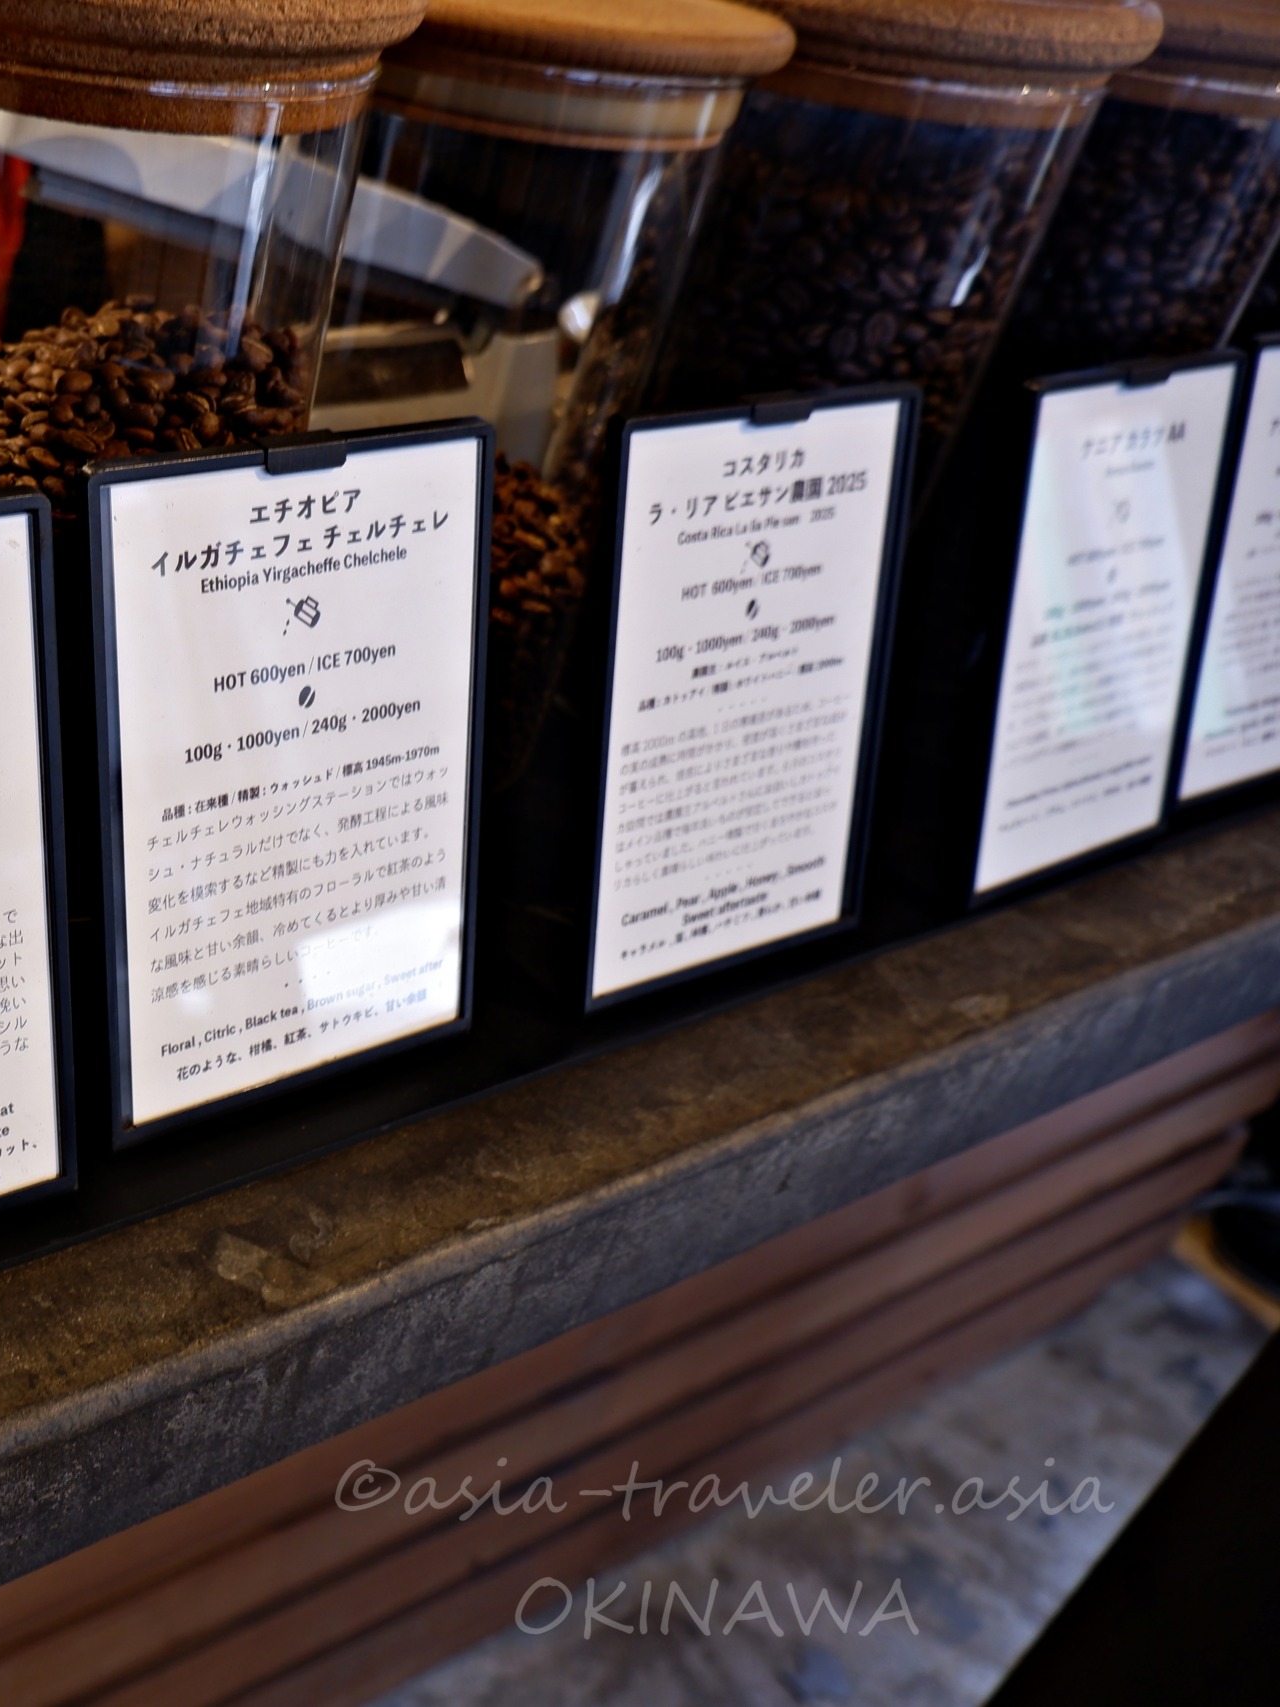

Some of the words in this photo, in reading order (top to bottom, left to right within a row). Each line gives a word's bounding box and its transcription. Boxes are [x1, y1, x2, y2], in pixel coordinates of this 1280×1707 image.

[721, 448, 806, 480] コスタリカ
[249, 489, 360, 523] エチオピア
[151, 534, 312, 576] イルガチェフェ
[323, 511, 448, 549] チェルチェレ
[201, 571, 259, 593] Ethiopia
[262, 556, 340, 583] Yirgacheffe
[343, 545, 406, 568] Chelchele
[214, 671, 246, 692] HOT
[250, 663, 305, 685] 600yen
[317, 652, 339, 671] ICE
[344, 645, 395, 665] 700yen
[162, 793, 228, 821] 品種：在来種
[237, 769, 331, 802] 精製：ウォッシュド
[342, 761, 363, 777] 標高
[366, 746, 439, 770] 1945m-1970m
[161, 1035, 195, 1057] Floral
[204, 1024, 235, 1042] Citric
[245, 1010, 276, 1029] Black
[280, 1006, 298, 1018] tea
[307, 989, 342, 1011] Brown
[418, 959, 443, 974] after
